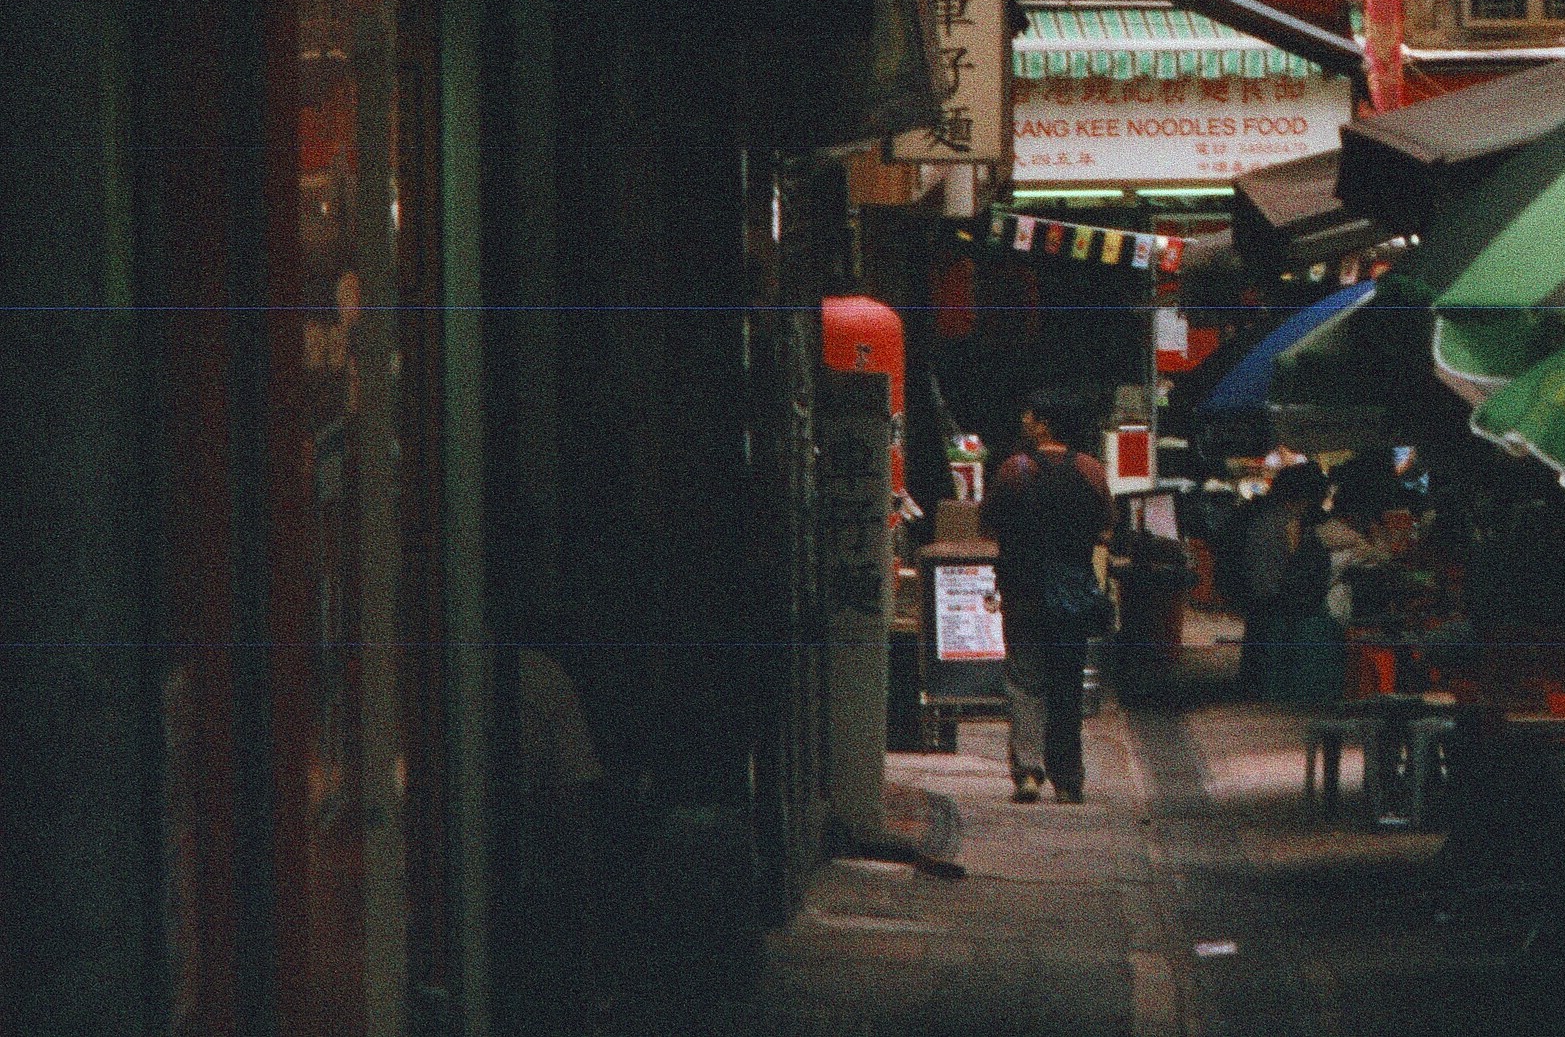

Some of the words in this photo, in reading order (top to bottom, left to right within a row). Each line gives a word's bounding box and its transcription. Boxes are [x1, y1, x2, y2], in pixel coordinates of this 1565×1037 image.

[1076, 119, 1121, 138] KEE
[1127, 117, 1236, 137] NOODLES
[1243, 115, 1308, 136] FOOD
